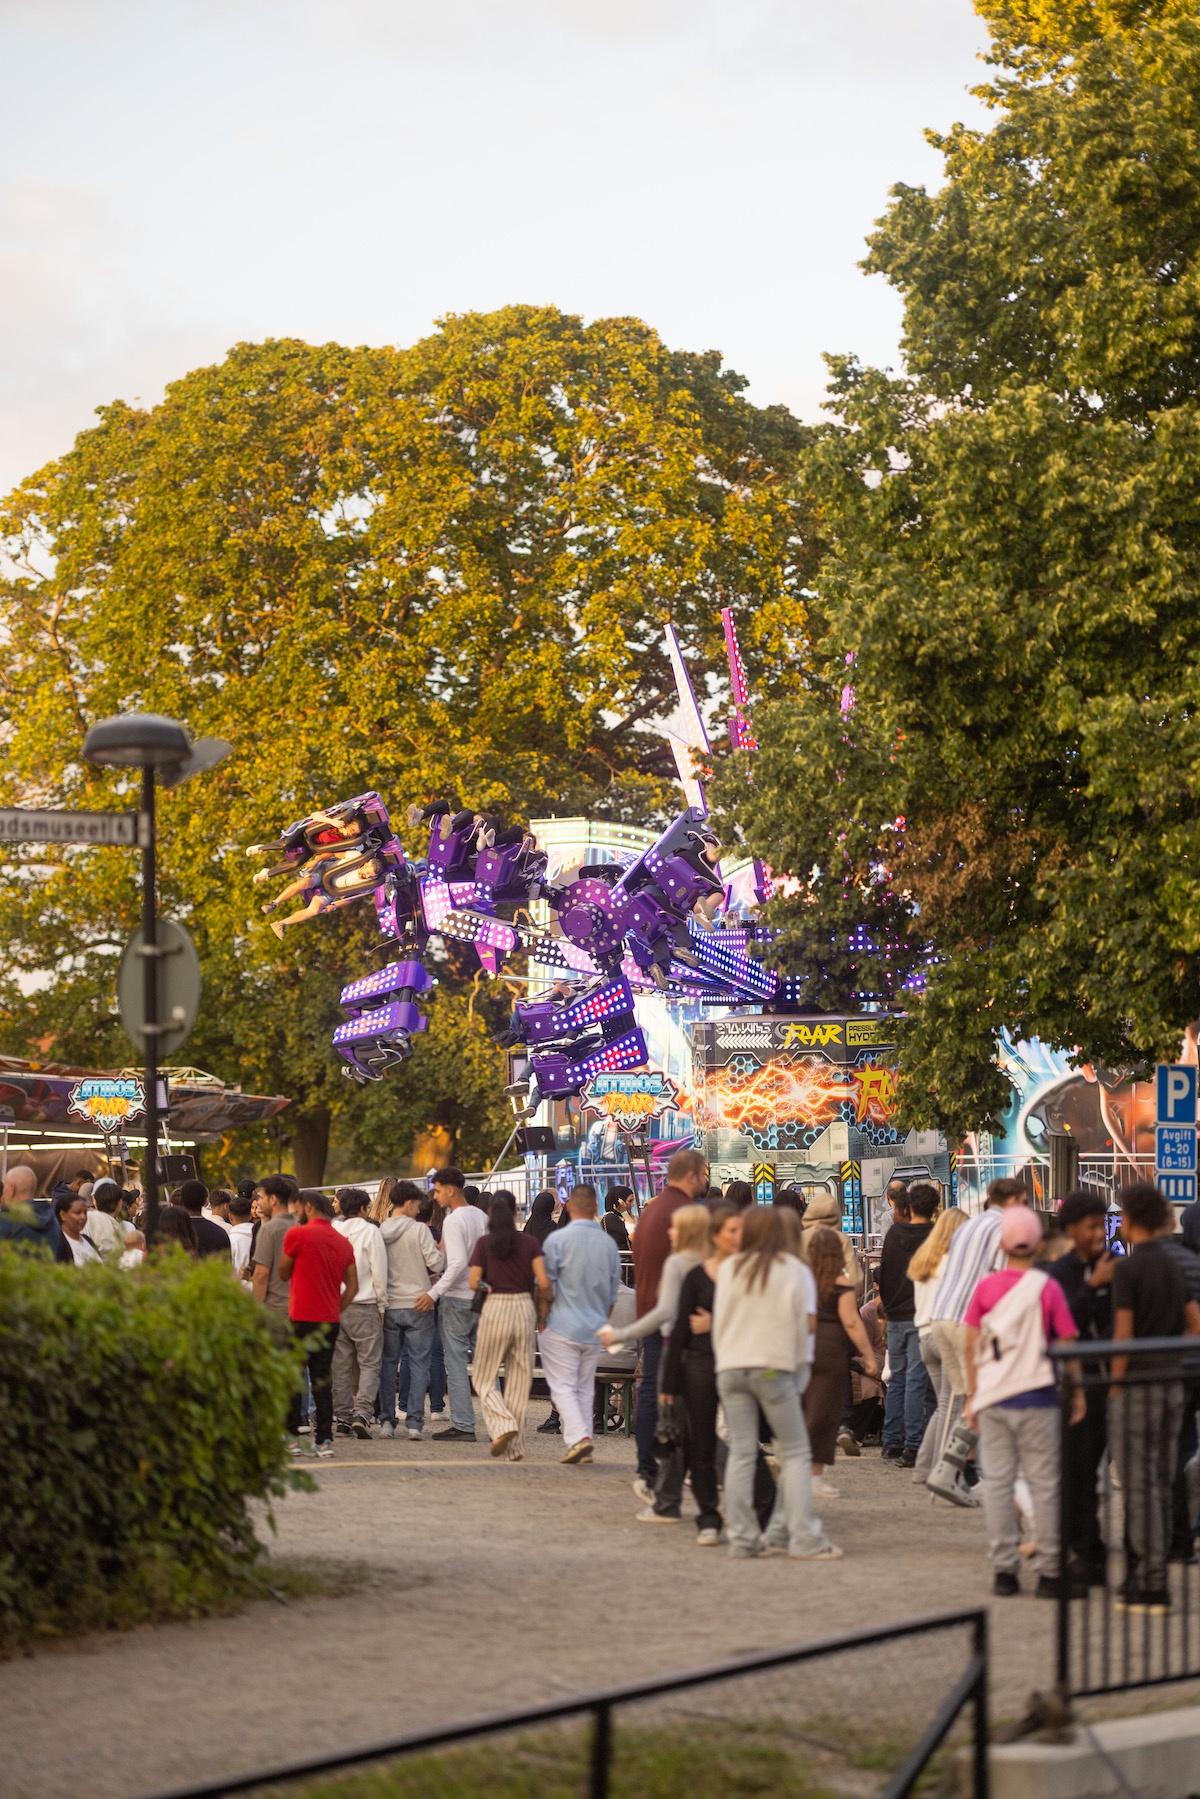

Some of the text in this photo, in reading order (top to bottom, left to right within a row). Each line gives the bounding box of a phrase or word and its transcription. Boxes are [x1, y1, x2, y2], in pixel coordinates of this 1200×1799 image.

[1167, 1070, 1190, 1118] P
[1162, 1130, 1192, 1143] Avgift
[1164, 1143, 1189, 1155] 8-20
[1162, 1156, 1192, 1168] (8-15)
